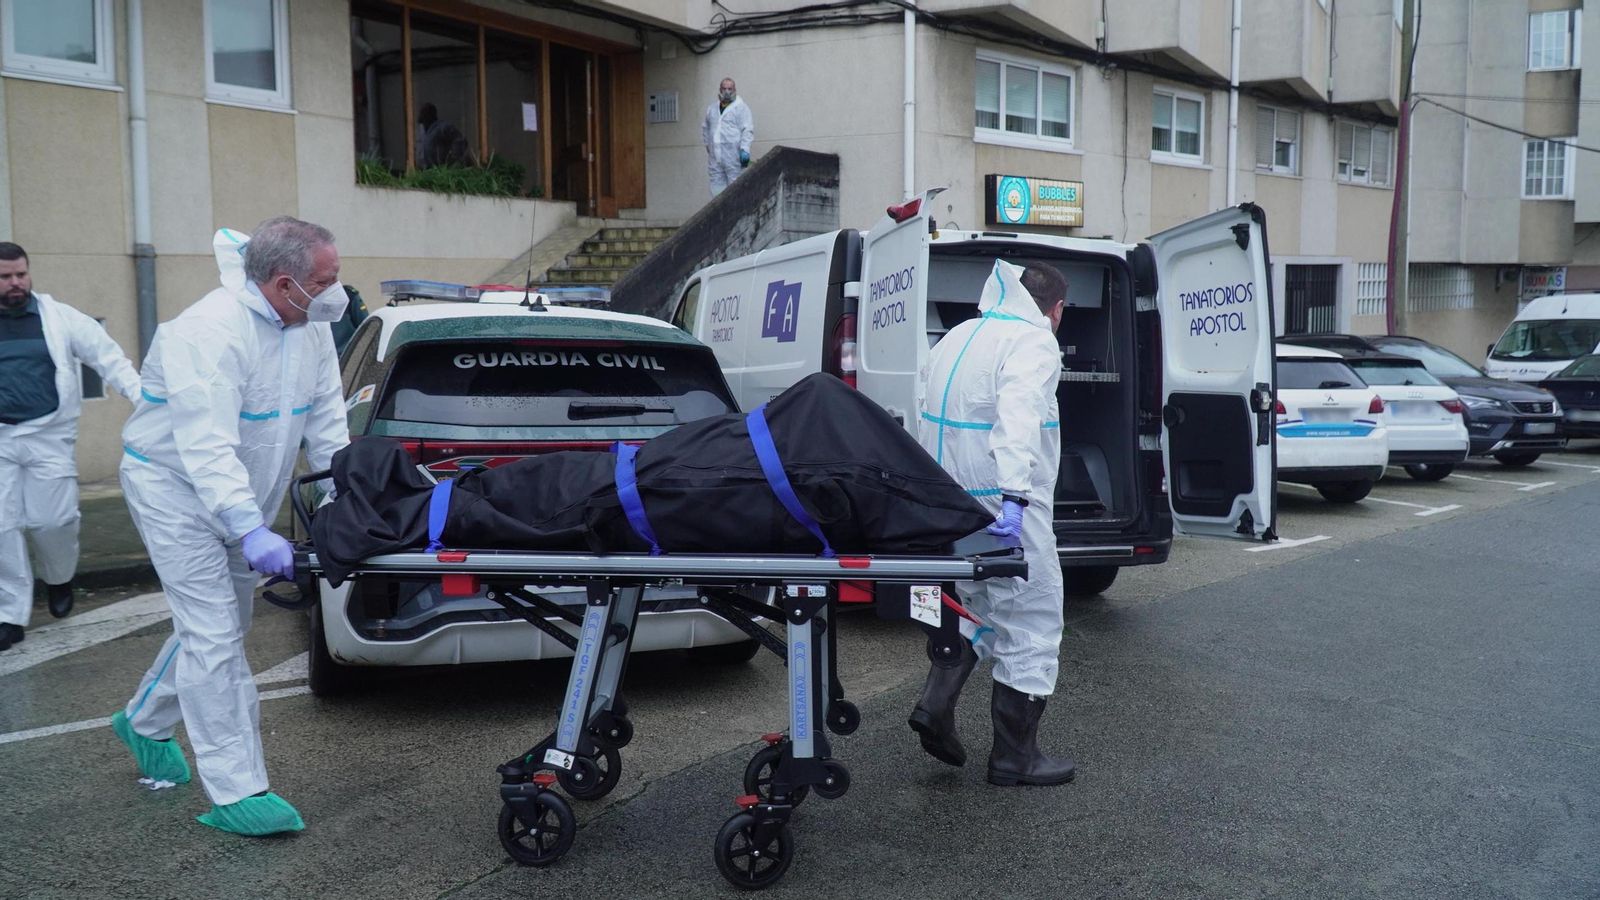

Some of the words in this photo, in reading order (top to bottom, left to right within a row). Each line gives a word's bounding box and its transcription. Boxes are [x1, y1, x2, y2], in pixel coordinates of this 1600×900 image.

[1039, 185, 1076, 201] BUBBLES
[870, 266, 914, 303] TANATORIOS
[1179, 282, 1253, 311] TANATORIOS
[711, 295, 741, 323] APOSTOL
[872, 301, 906, 331] APOSTOL
[1190, 312, 1246, 336] APOSTOL
[453, 352, 590, 369] GUARDIA
[596, 353, 665, 371] CIVIL
[796, 682, 806, 738] KARTSANA
